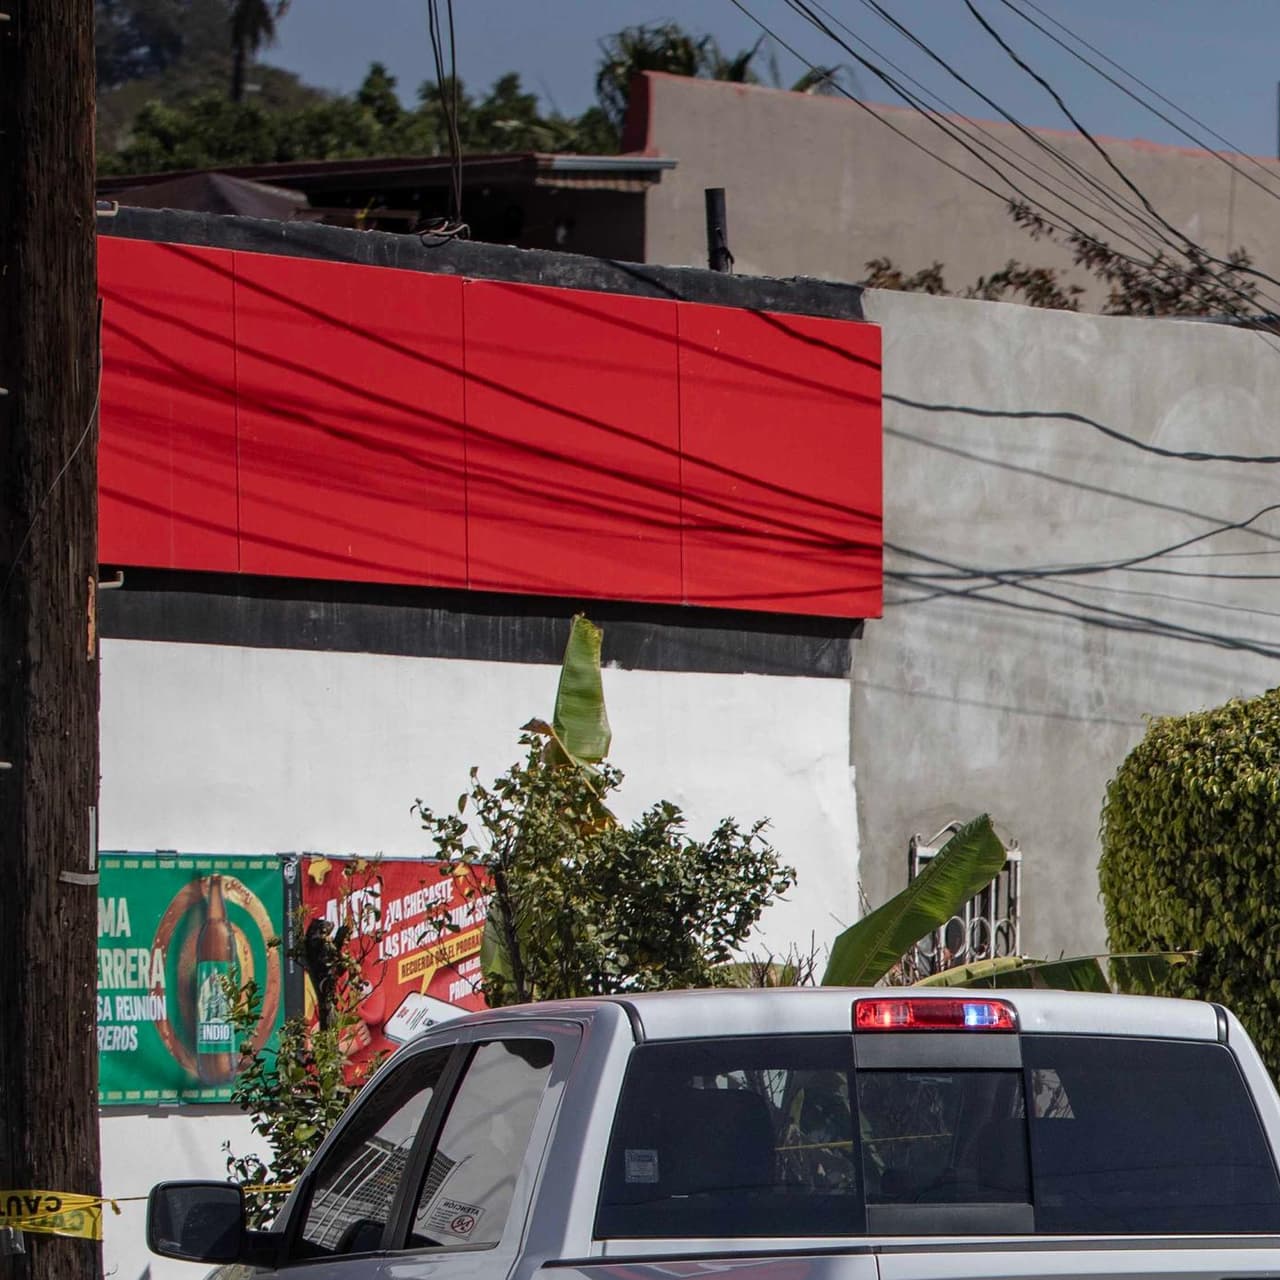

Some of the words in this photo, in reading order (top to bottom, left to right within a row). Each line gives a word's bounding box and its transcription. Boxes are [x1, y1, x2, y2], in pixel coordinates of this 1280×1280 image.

[97, 948, 166, 989] RRERA
[116, 994, 167, 1021] REUNIÓN
[203, 1024, 230, 1041] INDIO
[0, 1196, 63, 1217] CAU
